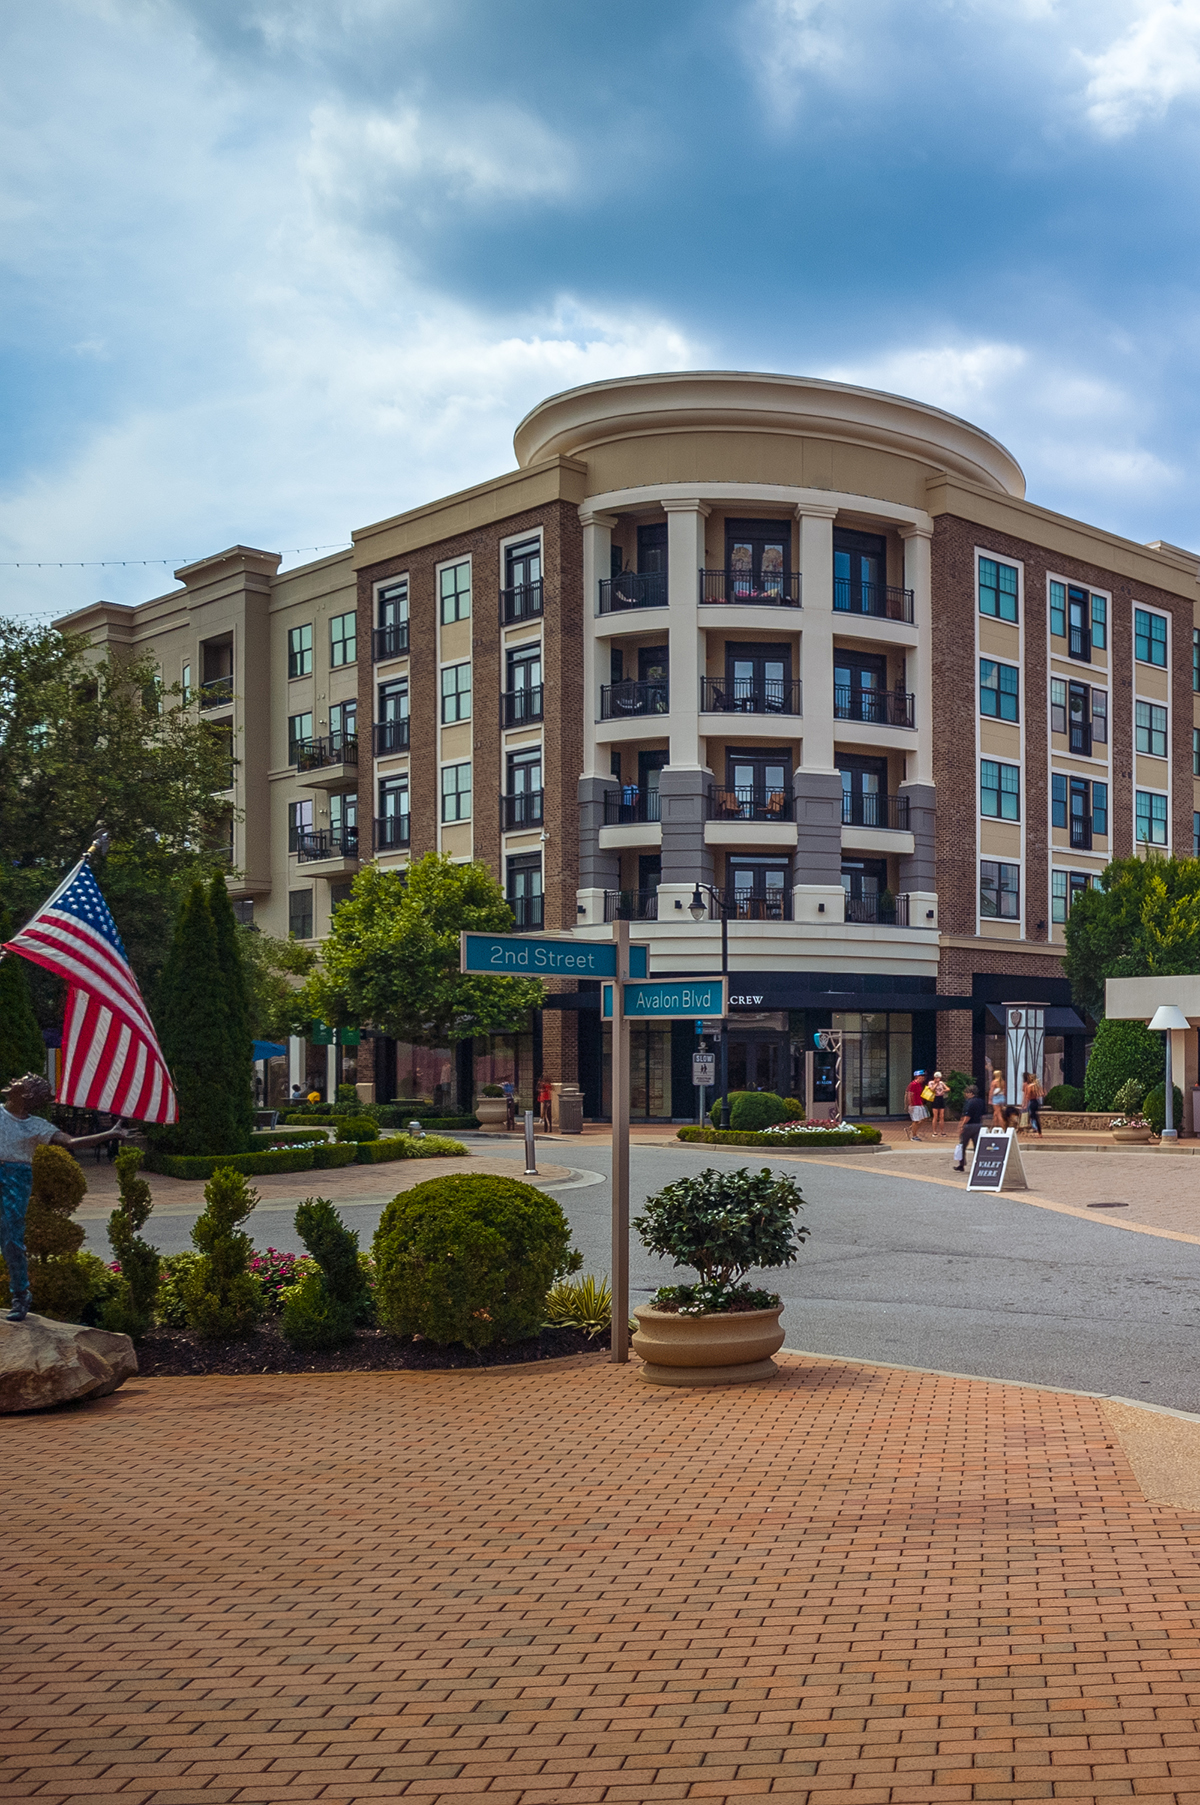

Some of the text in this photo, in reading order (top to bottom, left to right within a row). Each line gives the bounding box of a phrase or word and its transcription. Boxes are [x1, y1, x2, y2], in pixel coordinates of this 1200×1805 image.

[490, 945, 595, 969] 2nd Street
[636, 989, 711, 1009] Avalon Blvd
[727, 995, 764, 1005] .CREW
